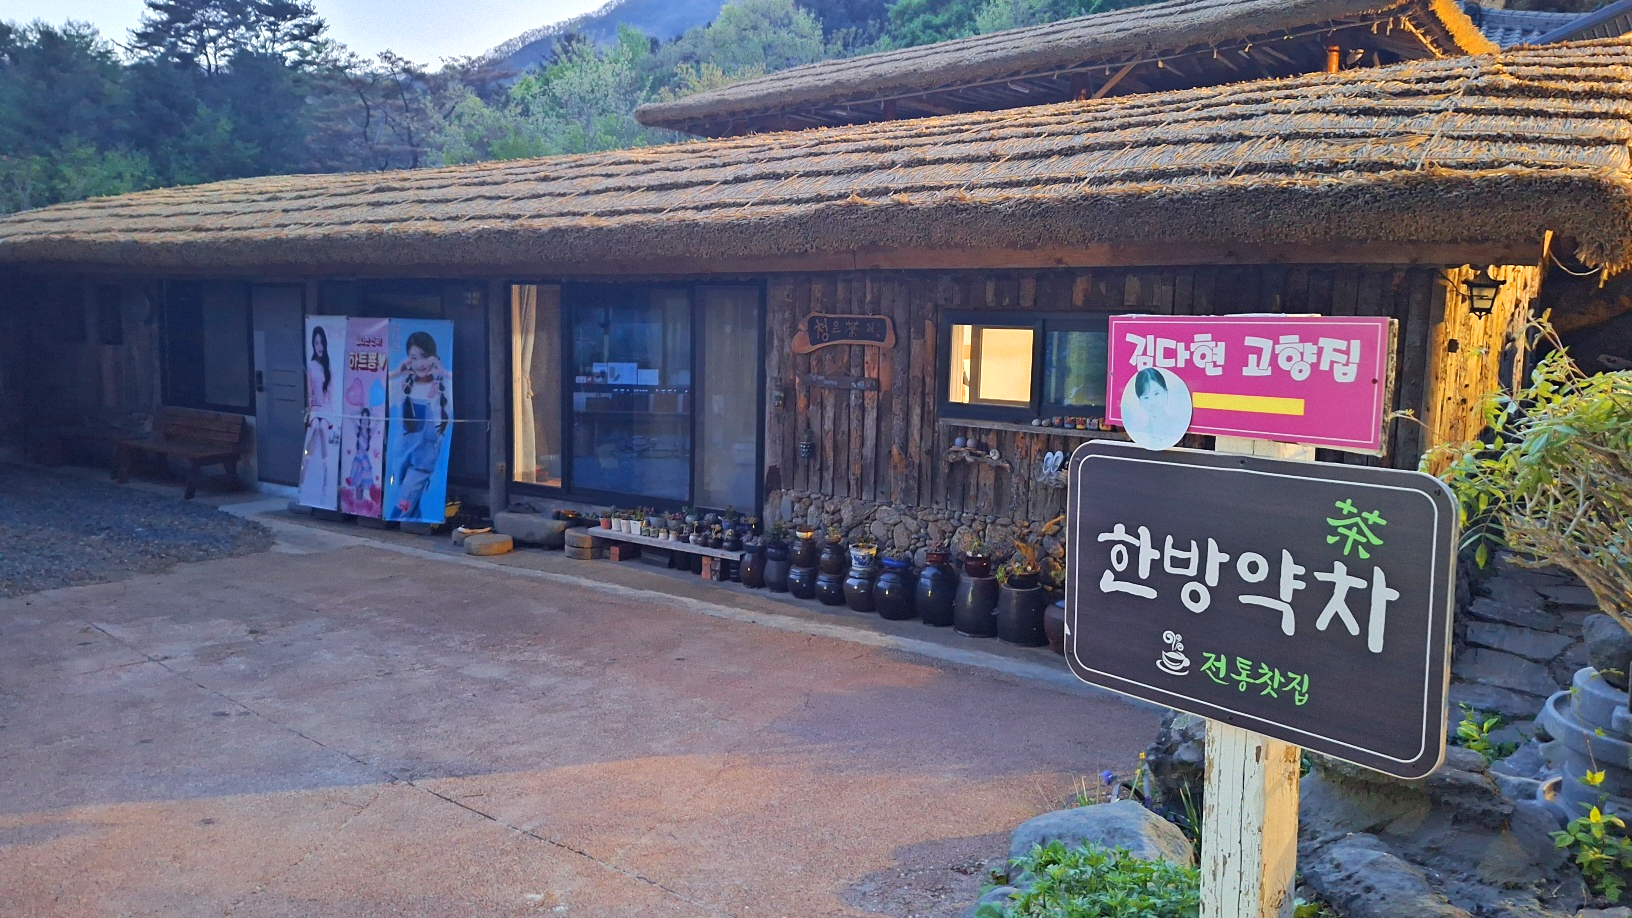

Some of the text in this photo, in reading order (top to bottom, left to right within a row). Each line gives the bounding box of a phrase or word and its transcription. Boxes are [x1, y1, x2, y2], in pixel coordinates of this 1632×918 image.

[1125, 332, 1361, 383] 김다현 고향집
[1326, 498, 1387, 559] 茶
[1097, 523, 1400, 653] 한방약차
[1200, 651, 1310, 706] 전통찻집
